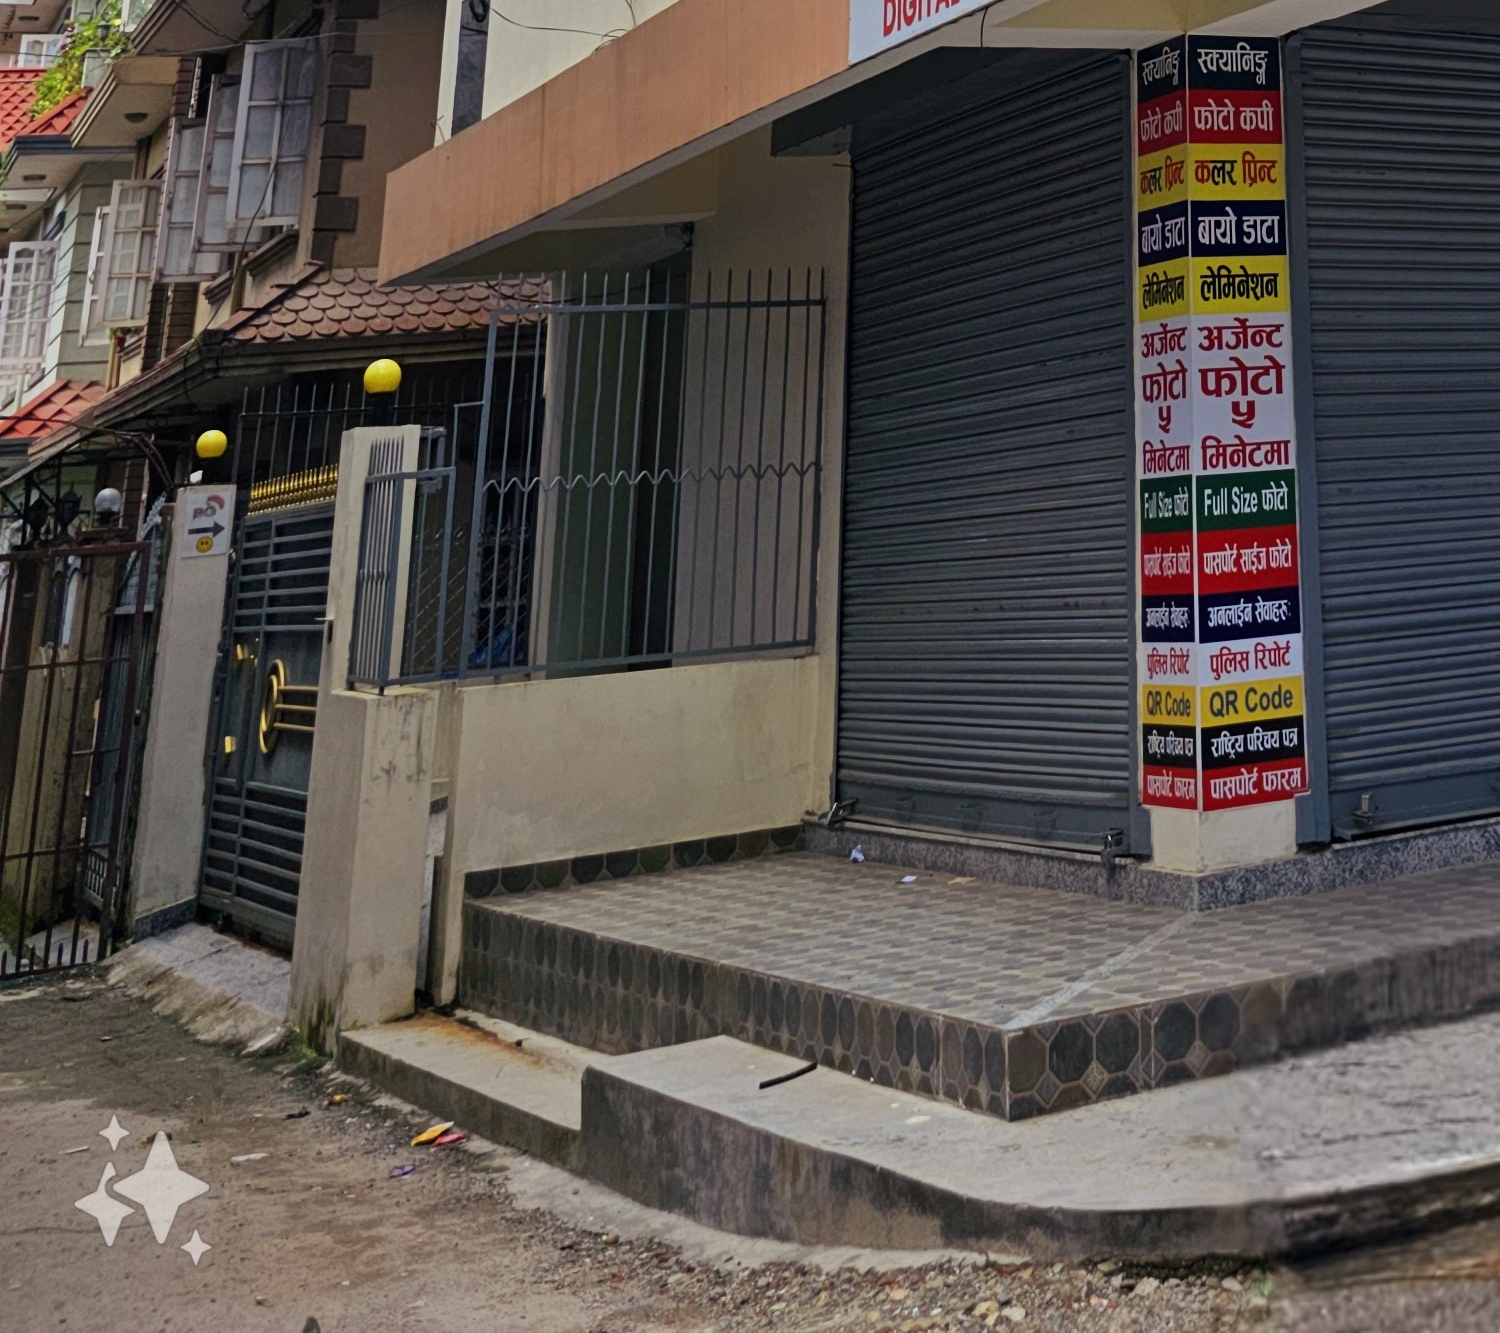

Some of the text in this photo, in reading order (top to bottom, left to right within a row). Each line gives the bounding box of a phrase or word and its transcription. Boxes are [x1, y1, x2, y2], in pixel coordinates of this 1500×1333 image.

[1141, 100, 1182, 142] फोटो कपी
[1194, 99, 1274, 131] फोटो कपी
[1141, 166, 1163, 194] कलर
[1195, 151, 1277, 187] कलर प्रिन्ट
[1142, 214, 1185, 253] बायो डाटा
[1198, 207, 1279, 245] बायो डाटा
[1200, 265, 1278, 301] लेमिनेशन
[1198, 317, 1284, 351] अर्जेन्ट
[1142, 359, 1188, 403] फोटो
[1198, 355, 1285, 397] फोटो
[1158, 405, 1171, 433] ५
[1231, 400, 1255, 429] ५
[1143, 439, 1190, 474] मिनेटमा
[1201, 434, 1290, 470] मिनेटमा
[1204, 481, 1288, 516] Full Size फोटो
[1203, 538, 1291, 575] पासपोर्ट साईज फोटो
[1208, 598, 1252, 627] अनलाईन
[1210, 640, 1291, 680] पुलिस रिपोर्ट
[1147, 690, 1191, 717] QR Code
[1209, 684, 1293, 718] QR Code
[1247, 726, 1279, 751] परिचय
[1283, 728, 1298, 747] पत्र
[1210, 767, 1301, 799] पासपोर्ट फारम
